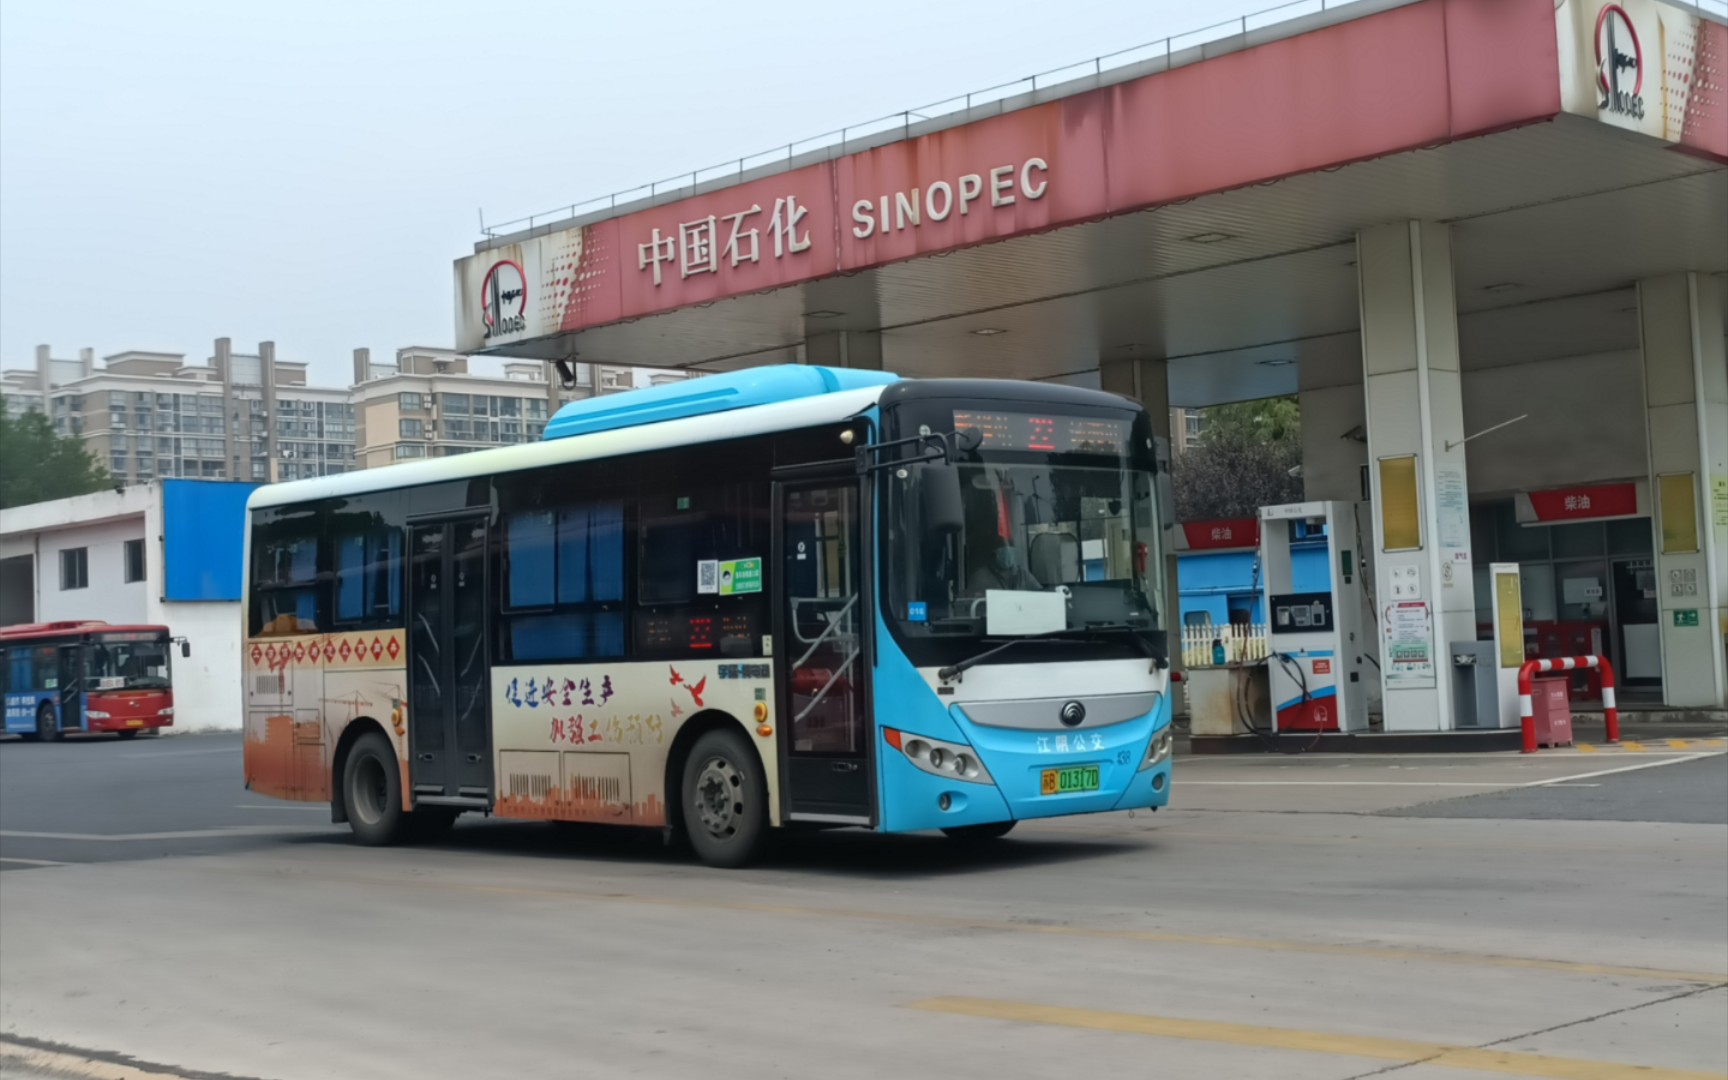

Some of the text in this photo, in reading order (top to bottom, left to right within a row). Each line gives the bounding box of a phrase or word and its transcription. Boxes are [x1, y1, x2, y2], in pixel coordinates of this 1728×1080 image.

[852, 157, 1048, 239] SINOPEC
[638, 195, 811, 287] 中国石化
[1564, 494, 1590, 511] 柴油
[1211, 527, 1232, 541] 柴油
[505, 674, 614, 708] 促进安全生产
